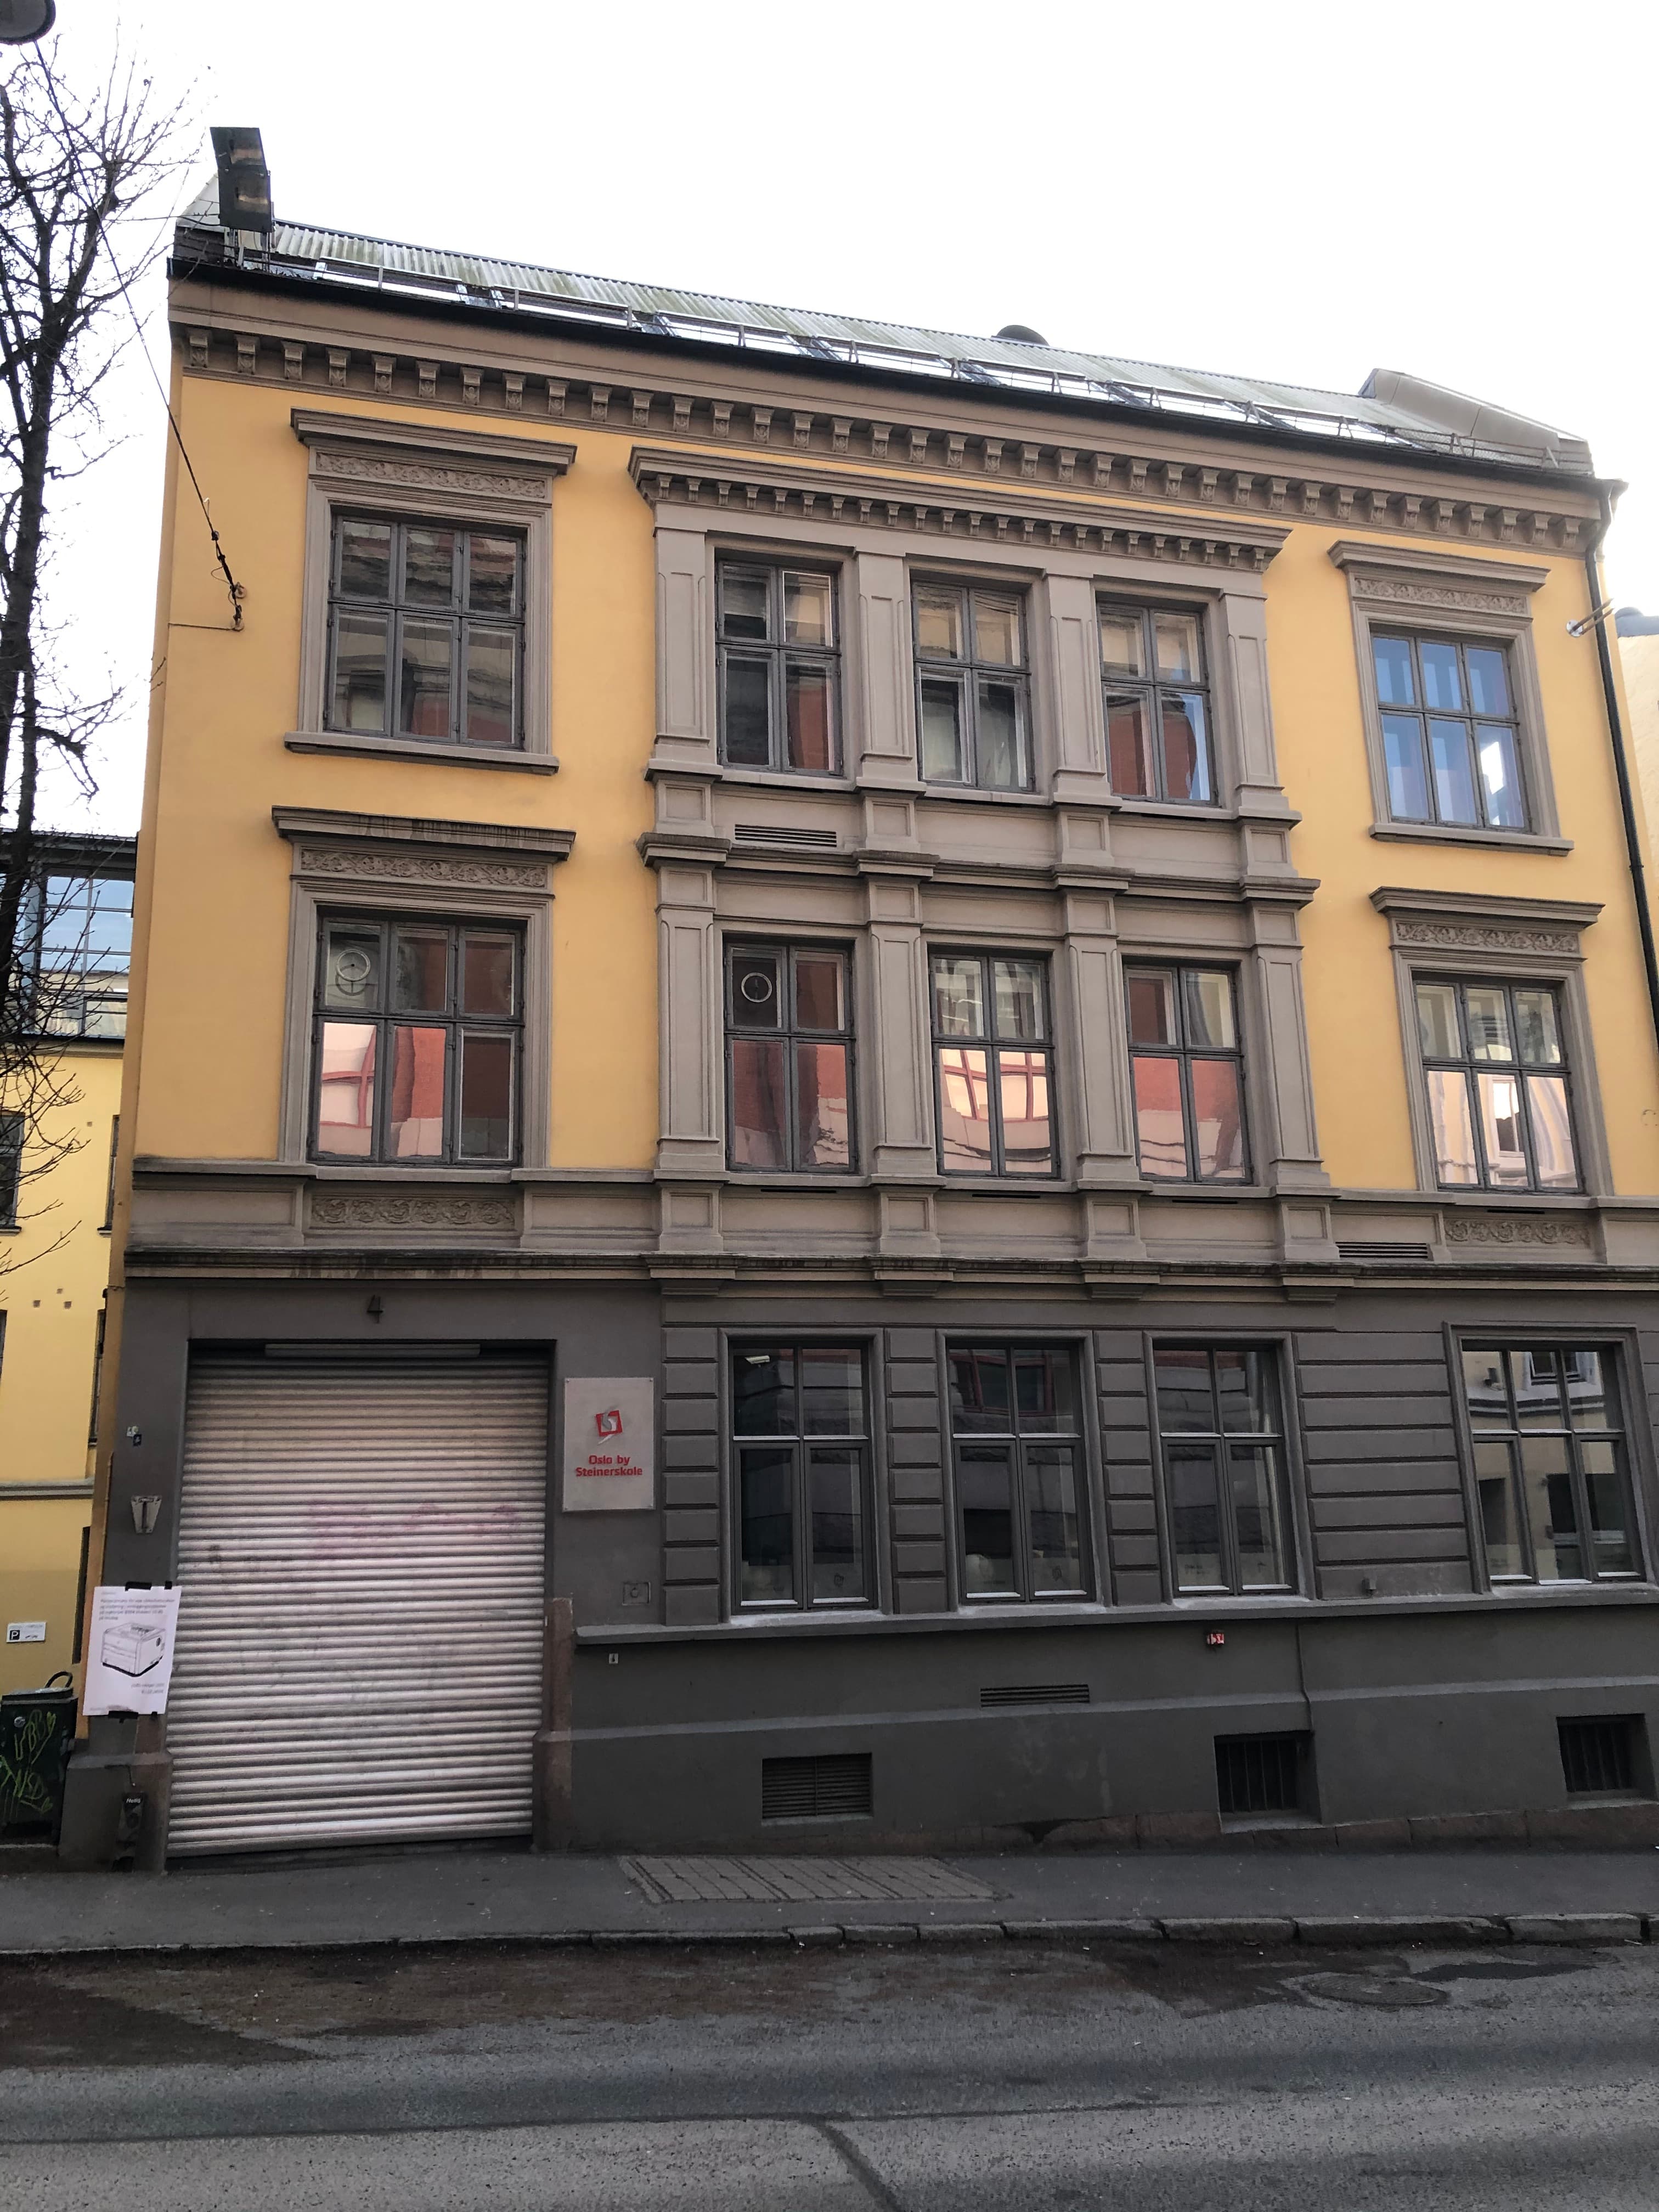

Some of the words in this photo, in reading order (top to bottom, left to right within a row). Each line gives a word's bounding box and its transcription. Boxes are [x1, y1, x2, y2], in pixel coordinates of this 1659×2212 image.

[588, 1455, 613, 1465] Oslo
[617, 1454, 630, 1466] by
[575, 1466, 643, 1477] Steinerskole
